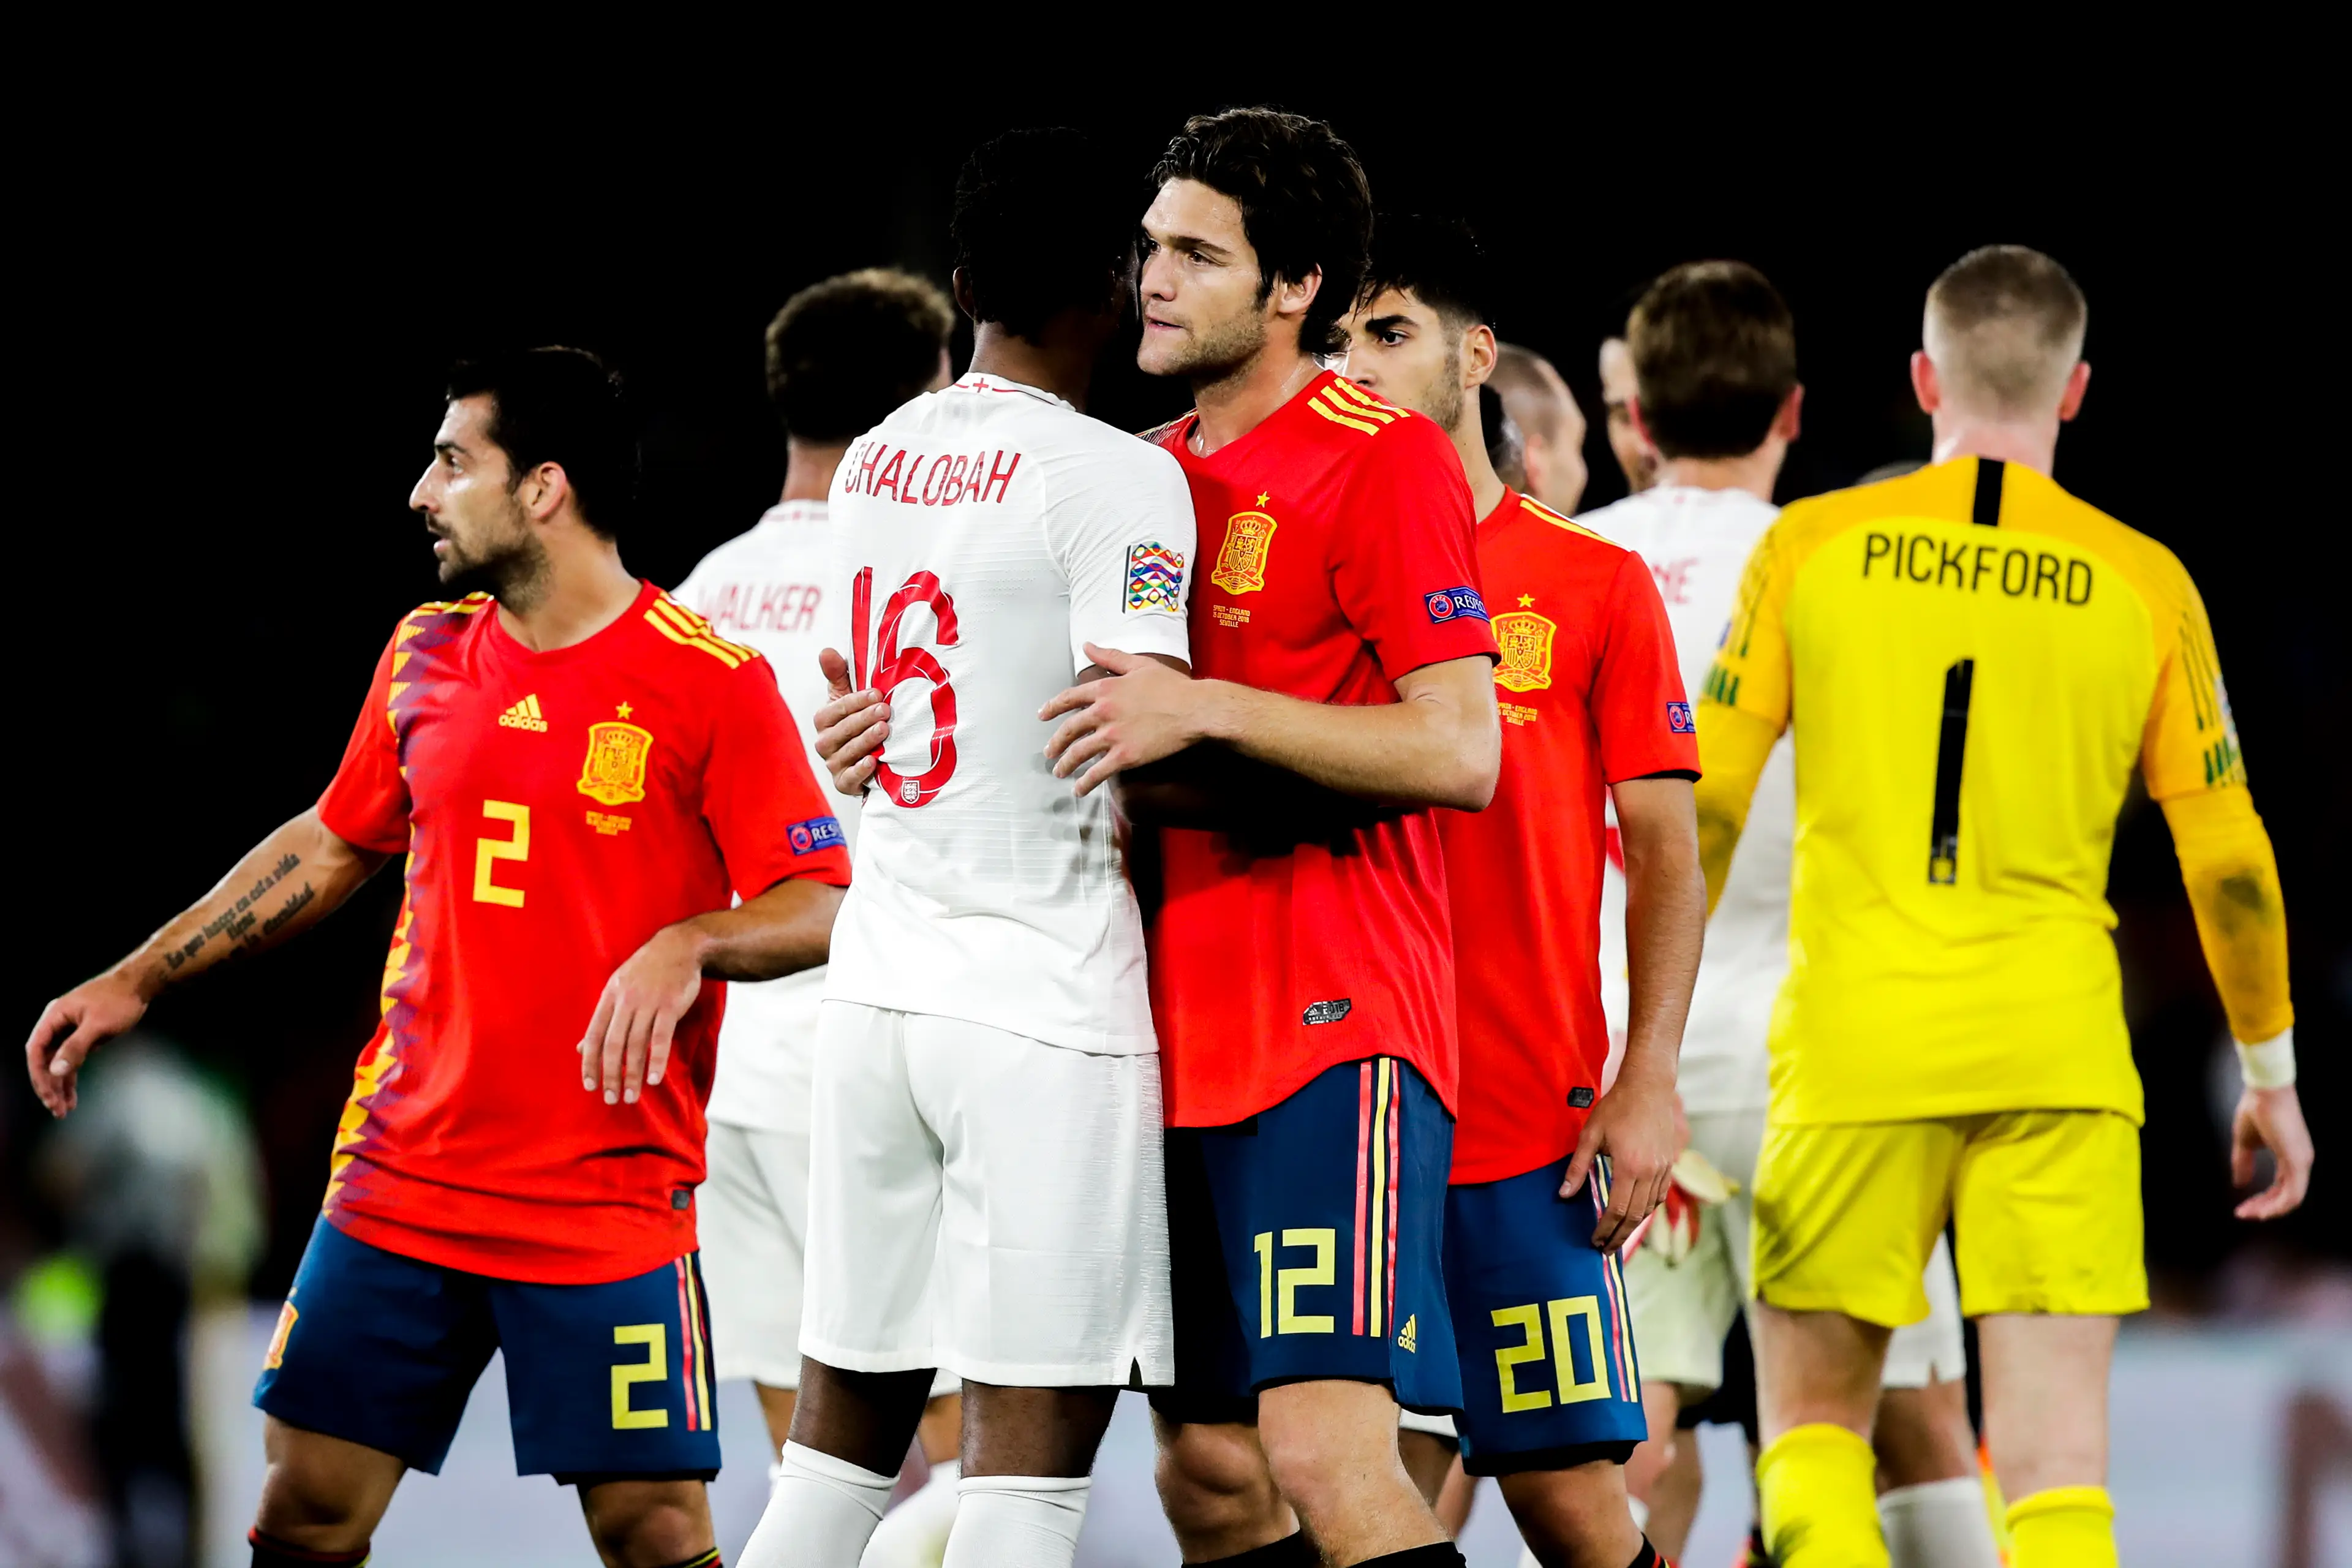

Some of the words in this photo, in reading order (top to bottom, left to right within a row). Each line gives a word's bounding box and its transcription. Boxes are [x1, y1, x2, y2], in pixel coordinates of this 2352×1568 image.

[845, 440, 1022, 507] CHALOBAH
[1651, 557, 1700, 604] NE
[1863, 532, 2093, 606] PICKFORD
[697, 585, 822, 631] WALKER
[1219, 619, 1238, 627] SEVILLE
[1229, 607, 1251, 617] ENGLAND
[1453, 595, 1487, 613] RESPEC
[851, 566, 959, 809] 16
[498, 714, 548, 733] adidas
[1928, 658, 1975, 885] 1
[472, 800, 530, 908] 2
[811, 823, 843, 842] RES
[1254, 1228, 1335, 1339] 12
[611, 1324, 668, 1430] 2
[1491, 1295, 1612, 1414] 20
